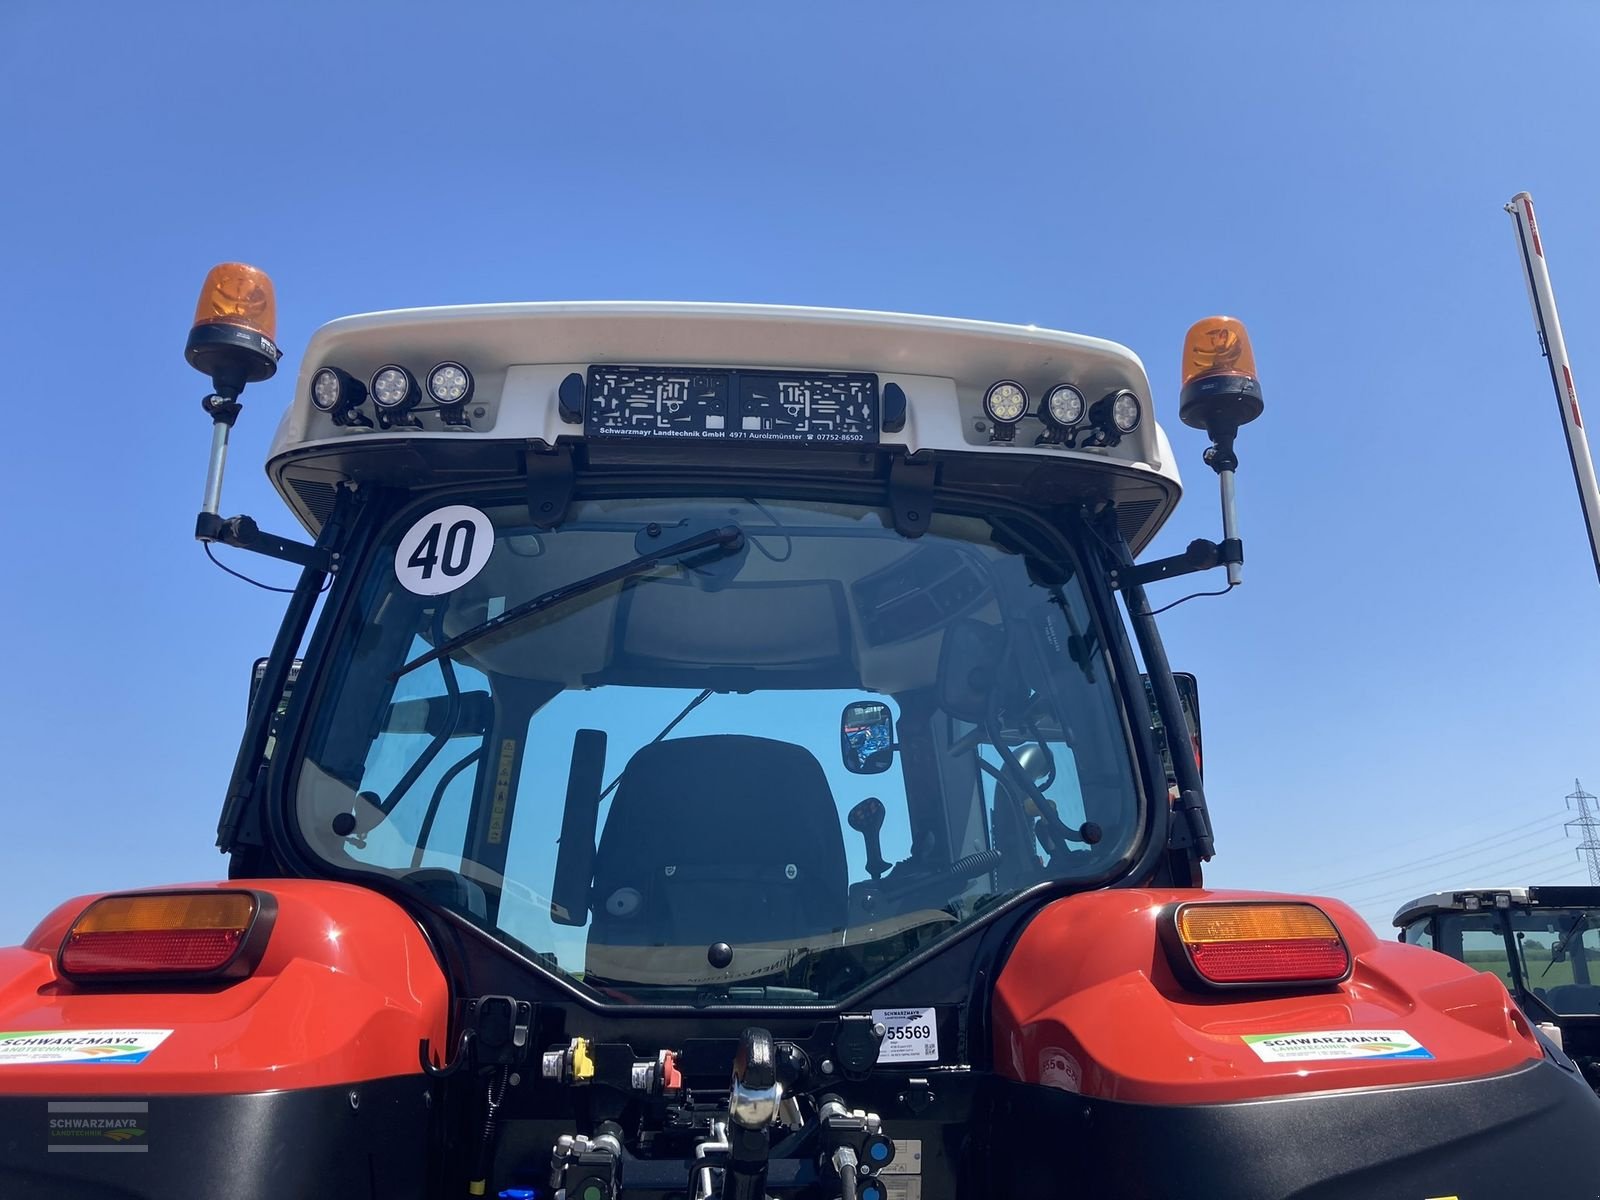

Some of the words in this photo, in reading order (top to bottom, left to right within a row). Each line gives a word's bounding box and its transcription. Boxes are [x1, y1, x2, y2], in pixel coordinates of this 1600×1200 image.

[600, 427, 651, 437] Schwarzmayr
[653, 429, 700, 437] Landtechnik
[749, 432, 802, 440] Aurolzmünster
[407, 519, 476, 580] 40
[887, 1025, 930, 1040] 55569
[1, 1037, 138, 1046] SCHWARZMAYR
[1263, 1036, 1392, 1046] SCHWARZMAYR
